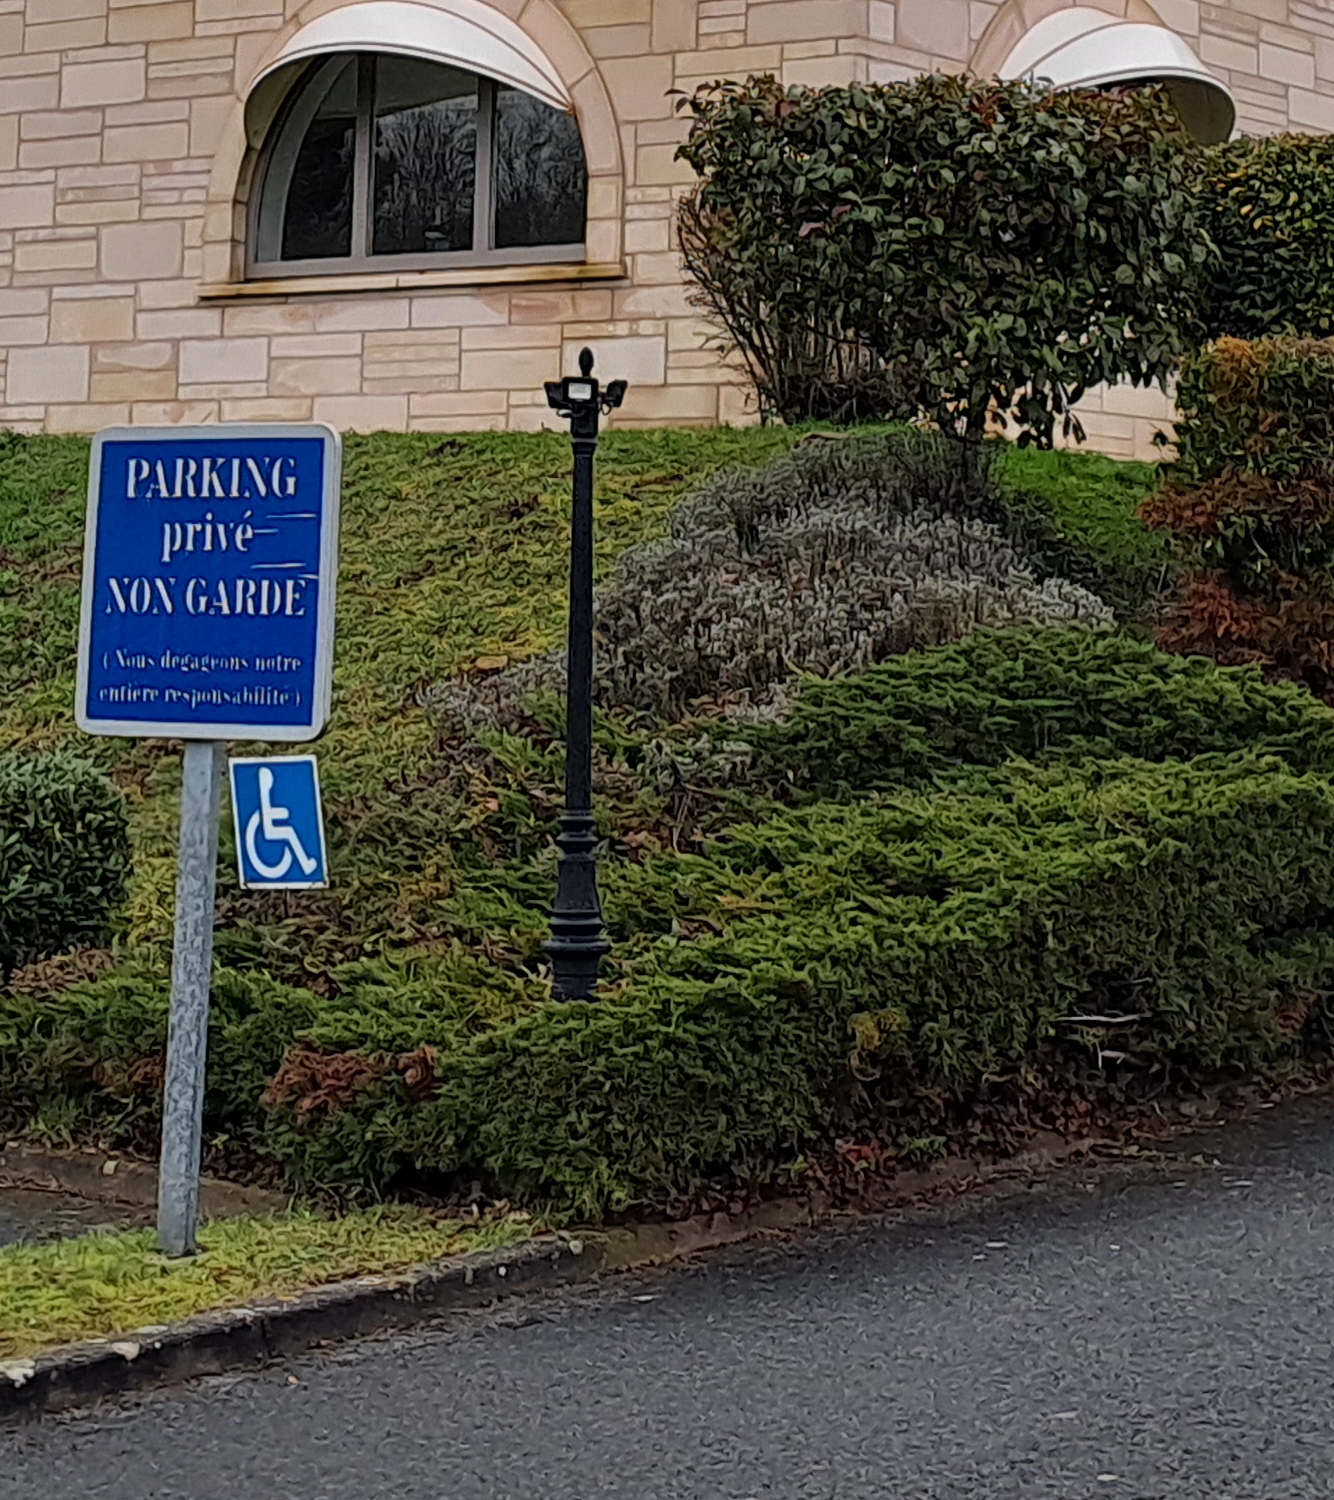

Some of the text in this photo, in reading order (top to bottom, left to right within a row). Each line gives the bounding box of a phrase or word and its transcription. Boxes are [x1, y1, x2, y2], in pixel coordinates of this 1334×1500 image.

[126, 457, 296, 499] PARKING
[161, 510, 254, 563] privé
[105, 577, 176, 615] NON
